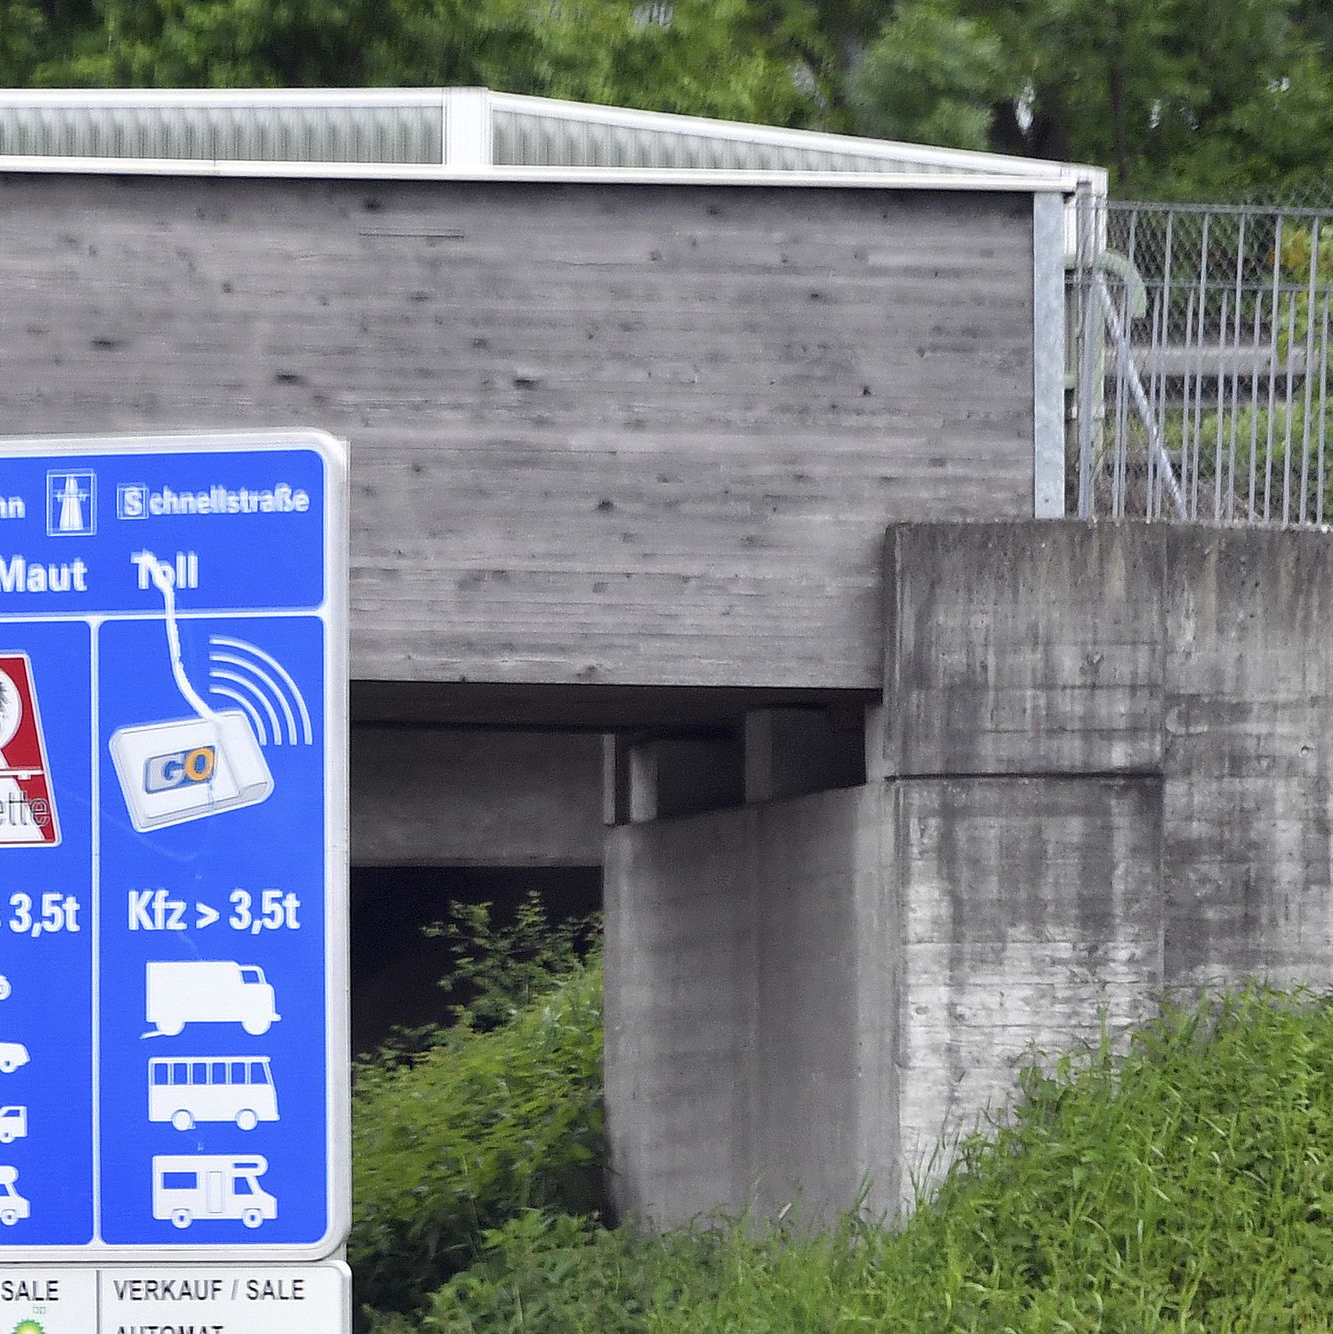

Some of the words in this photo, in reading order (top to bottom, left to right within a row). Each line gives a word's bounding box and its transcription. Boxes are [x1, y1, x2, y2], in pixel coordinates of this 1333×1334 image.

[122, 483, 309, 516] Schnellstraße
[131, 550, 198, 590] Toll
[163, 747, 217, 784] GO
[9, 893, 81, 937] 3,5t
[128, 890, 187, 931] Kfz
[229, 890, 301, 935] 3,5t
[1, 1280, 60, 1302] SALE
[114, 1279, 222, 1301] VERKAUF
[245, 1279, 305, 1301] SALE
